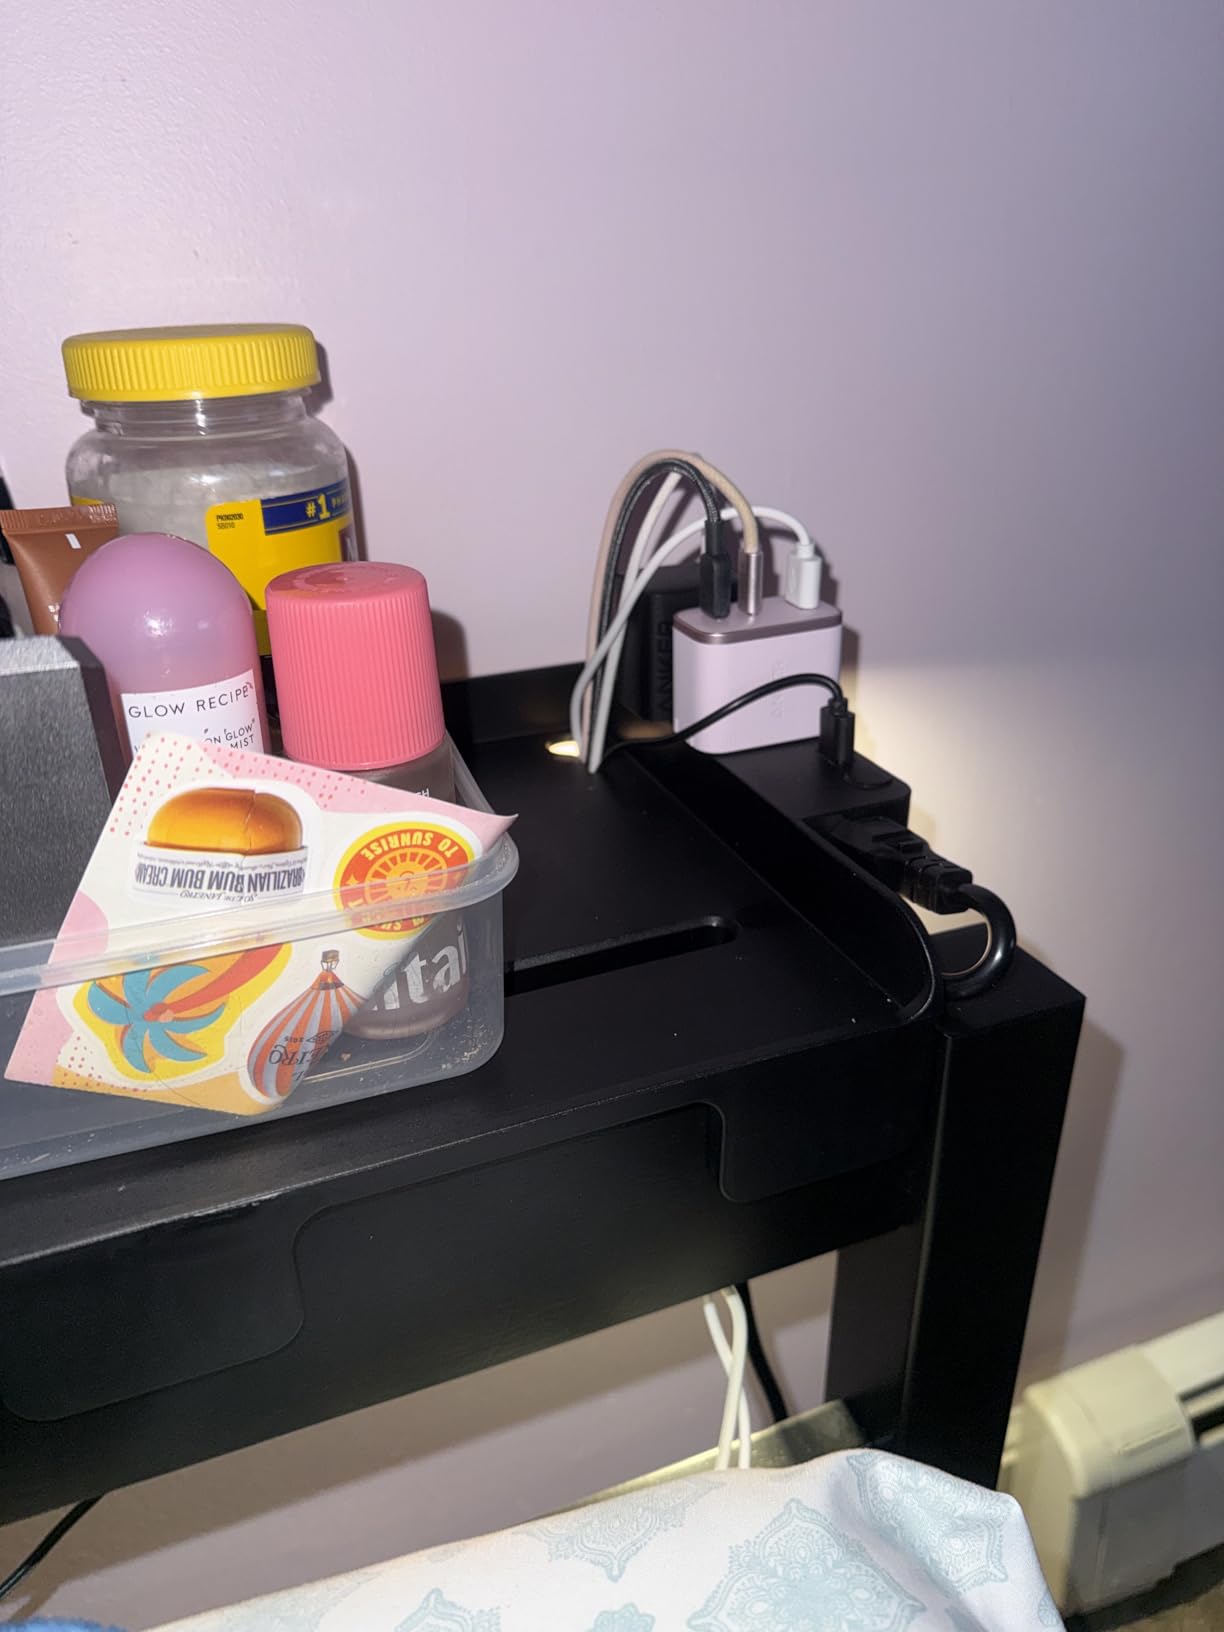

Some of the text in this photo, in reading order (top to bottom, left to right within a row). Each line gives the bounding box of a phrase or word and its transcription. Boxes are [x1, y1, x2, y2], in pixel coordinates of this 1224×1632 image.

[305, 493, 331, 520] #1
[128, 685, 249, 718] GLOW RECIPE
[230, 733, 254, 749] MIST
[360, 831, 459, 861] TO SUNRISE
[170, 867, 206, 889] BUM
[207, 870, 246, 893] BUM
